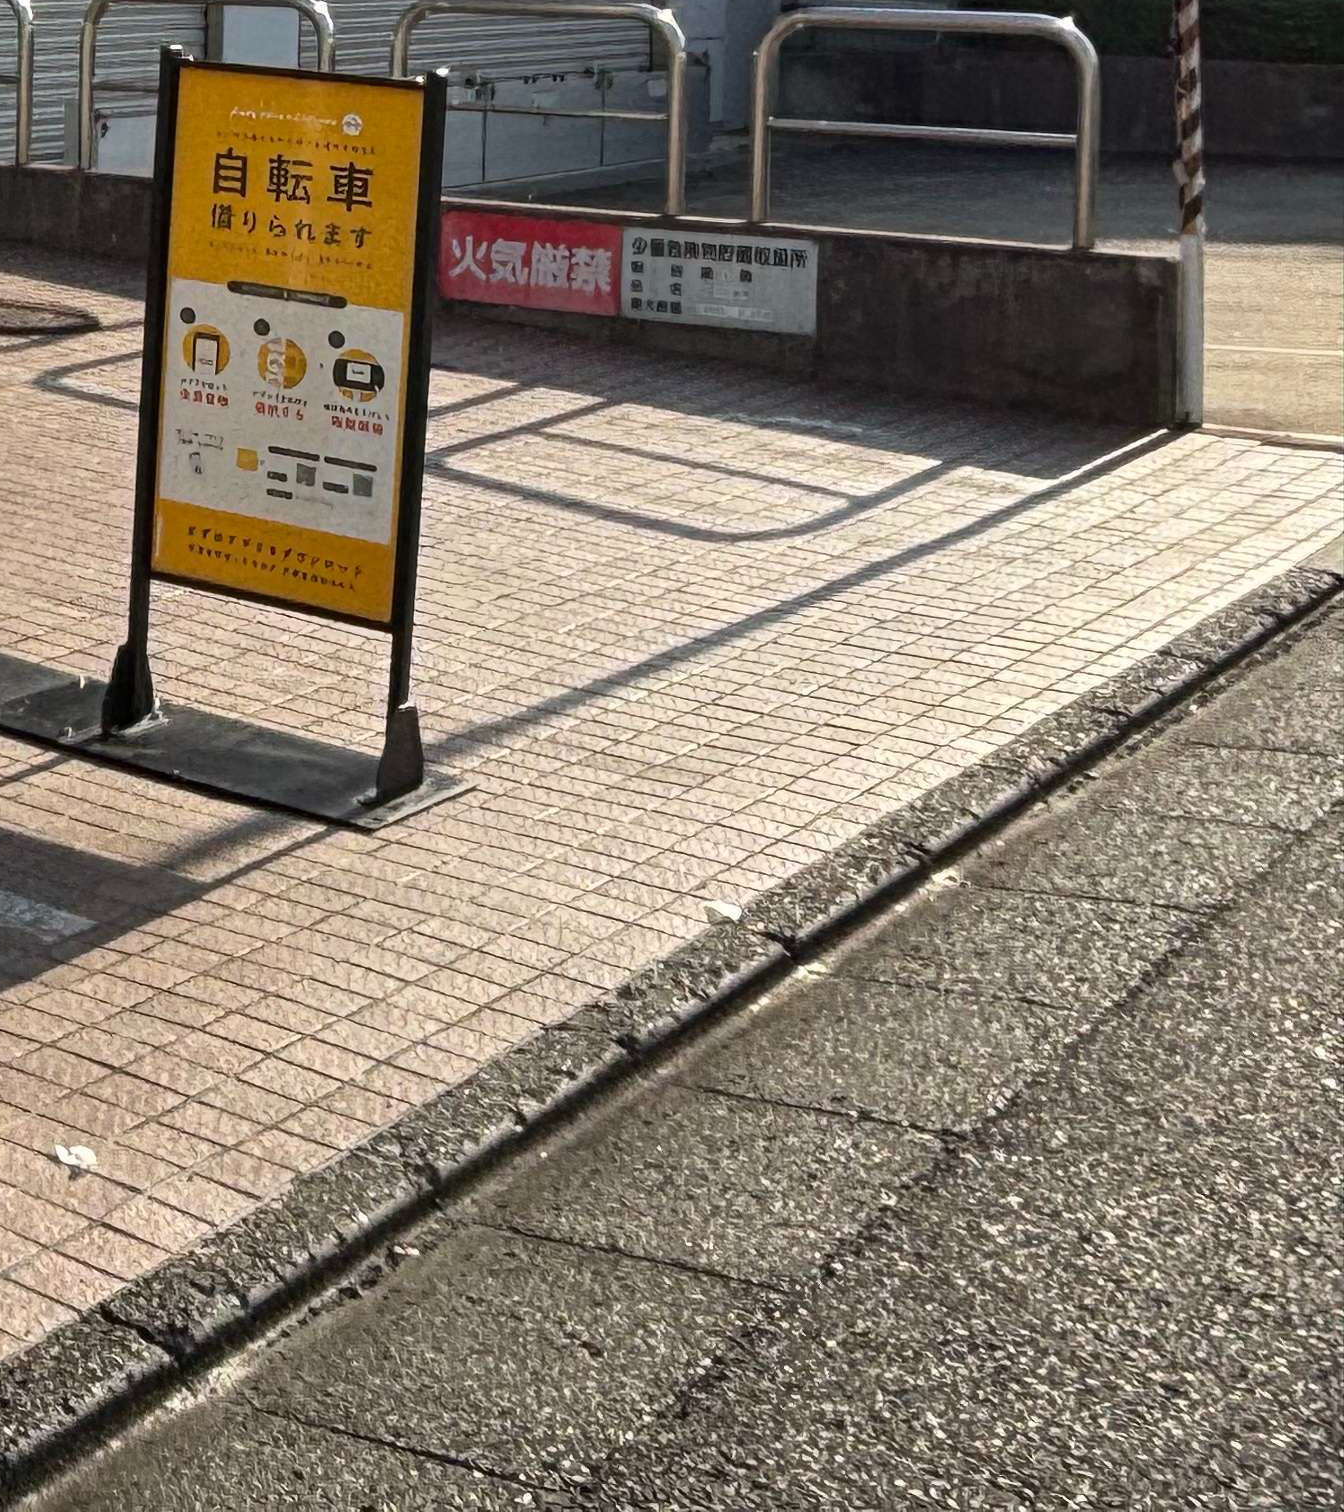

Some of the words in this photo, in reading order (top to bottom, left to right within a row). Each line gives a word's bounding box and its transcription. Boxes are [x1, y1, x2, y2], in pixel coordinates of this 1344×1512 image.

[212, 147, 375, 212] 自転車
[211, 203, 372, 249] 借りられます
